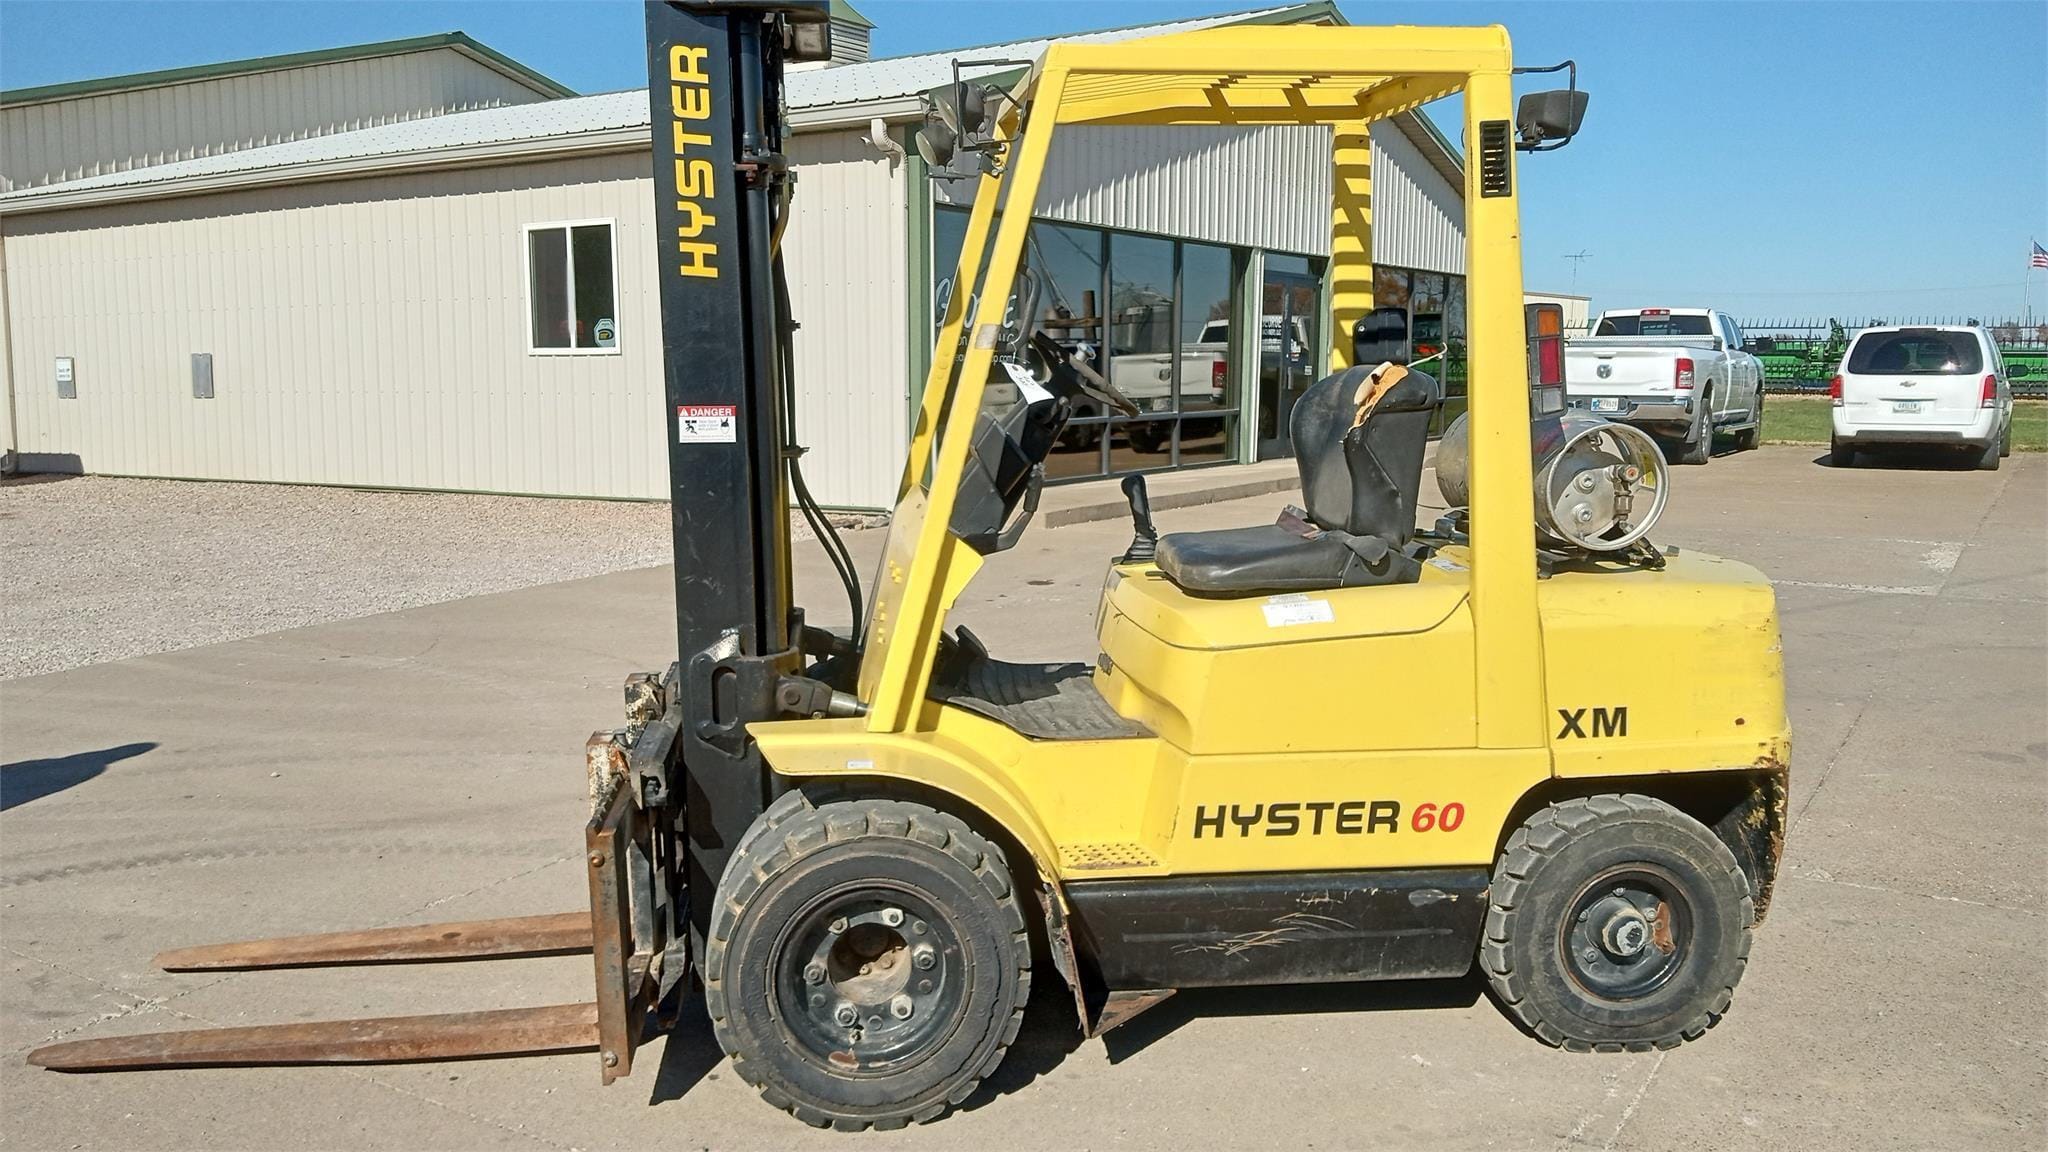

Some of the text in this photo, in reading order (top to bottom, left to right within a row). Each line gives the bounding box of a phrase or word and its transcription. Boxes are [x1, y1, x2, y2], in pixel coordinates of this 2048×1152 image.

[670, 45, 719, 279] HYSTER
[690, 408, 732, 416] DANGER
[1556, 706, 1628, 739] XM
[1193, 801, 1465, 839] HYSTER 60
